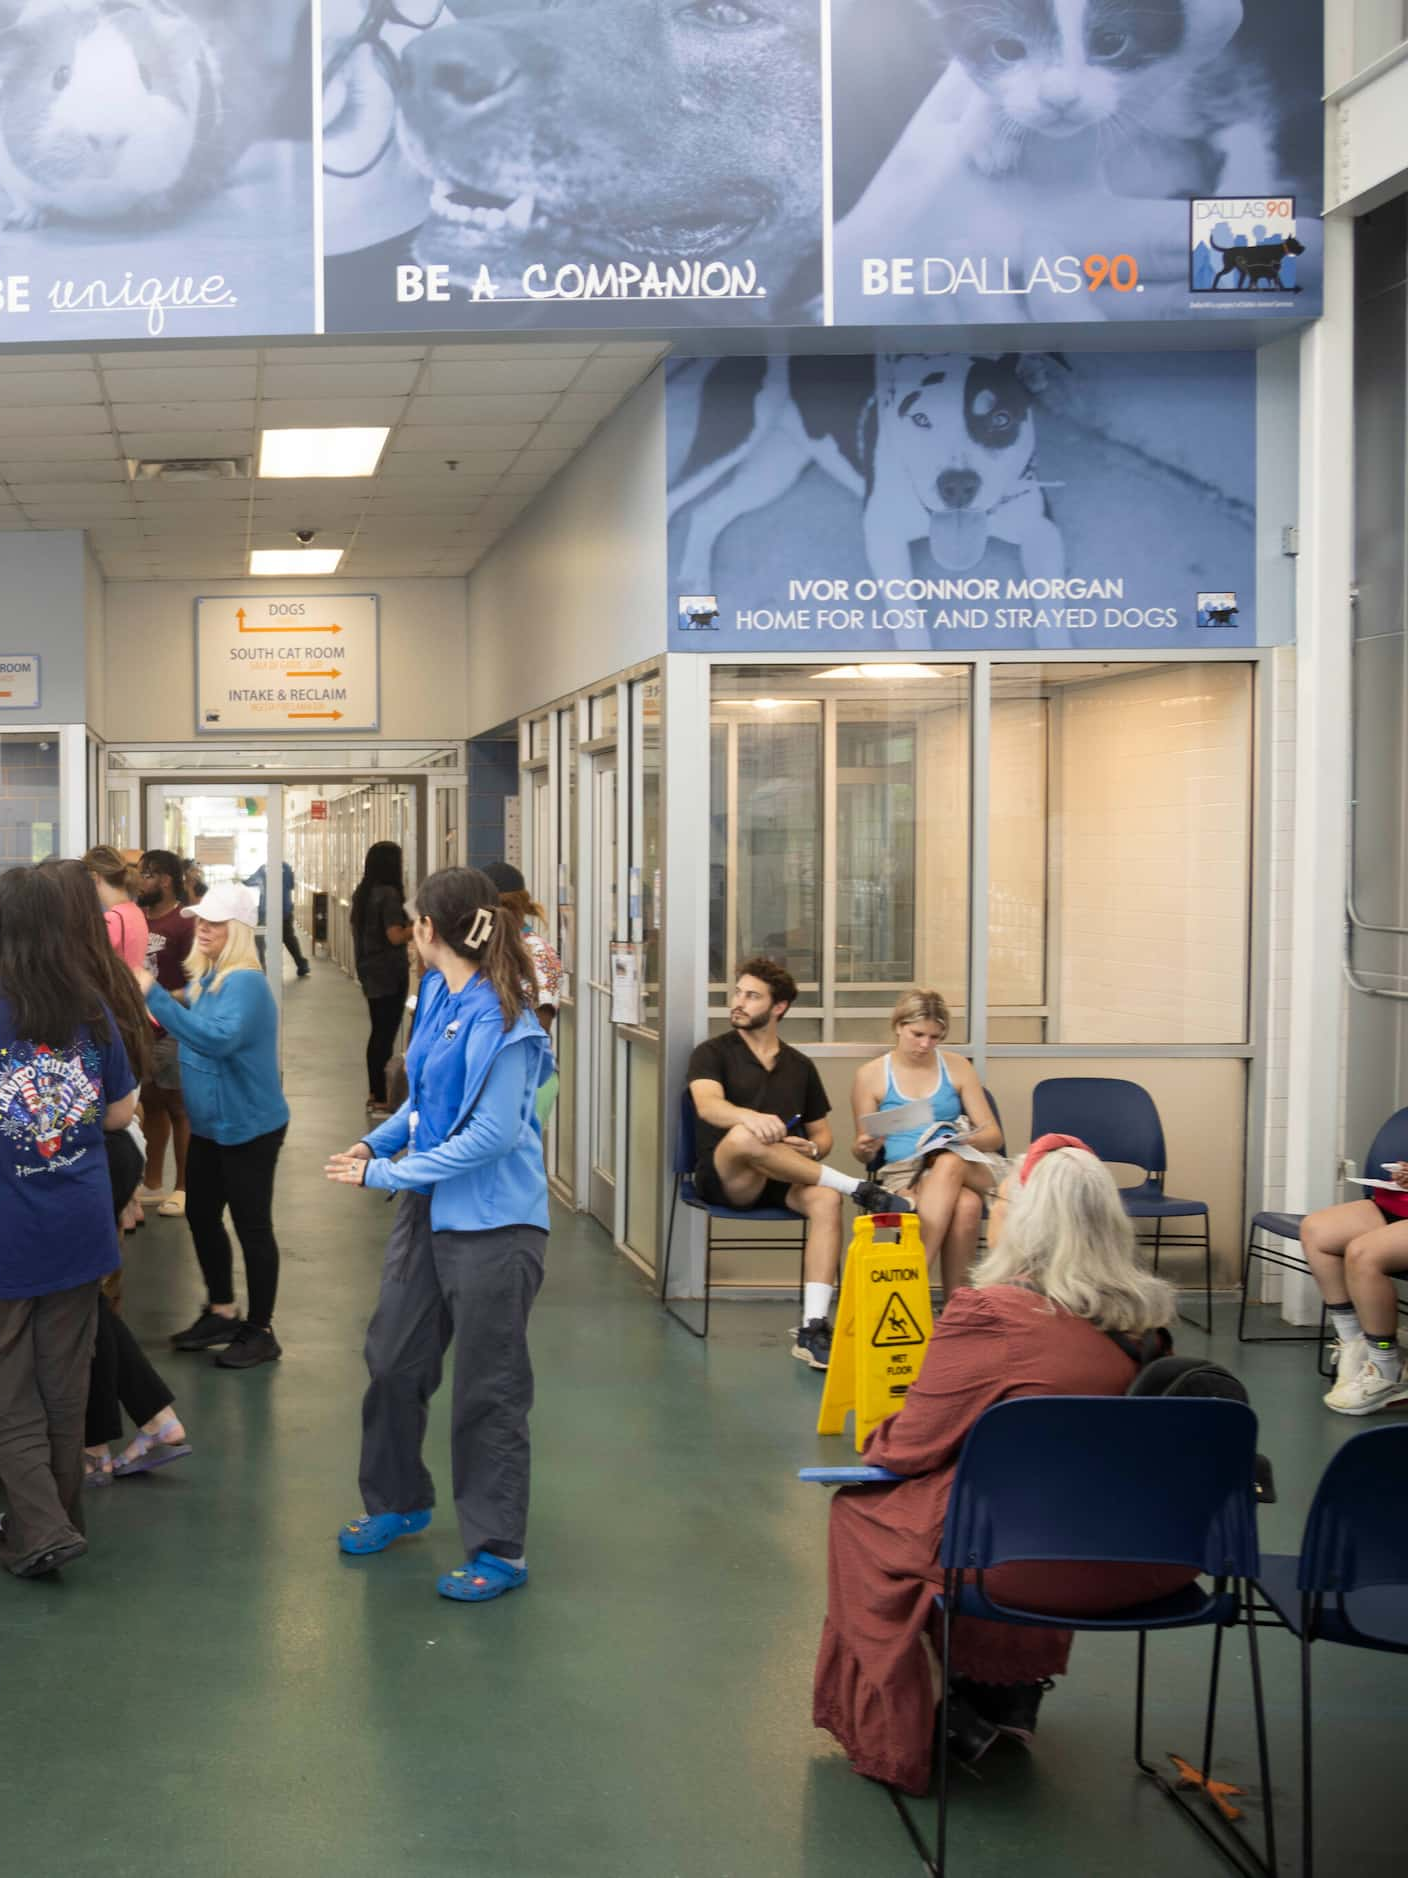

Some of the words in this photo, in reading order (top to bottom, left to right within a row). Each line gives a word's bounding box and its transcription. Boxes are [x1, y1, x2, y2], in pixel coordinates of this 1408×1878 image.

[1196, 201, 1289, 219] DALLAS90
[396, 264, 450, 301] BE
[471, 264, 499, 300] A
[522, 260, 766, 298] COMPANION.
[862, 258, 913, 296] BE
[923, 253, 1144, 295] DALLAS90.
[48, 272, 238, 335] unique.
[789, 580, 849, 600] IVOR
[855, 579, 999, 600] O'CONNOR
[1006, 578, 1124, 599] MORGAN
[269, 604, 305, 616] DOGS
[736, 610, 810, 630] HOME
[817, 610, 864, 630] FOR
[872, 609, 928, 629] LOST
[934, 608, 988, 629] AND
[995, 608, 1097, 628] STRAYED
[1104, 607, 1177, 628] DOGS
[230, 648, 274, 660] SOUTH
[278, 647, 303, 660] CAT
[305, 646, 345, 659] ROOM
[0, 663, 32, 673] ROOM
[228, 689, 273, 702] INTAKE
[278, 689, 287, 701] &
[290, 688, 347, 701] RECLAIM
[871, 1268, 919, 1282] CAUTION
[891, 1354, 908, 1363] WET
[887, 1366, 912, 1375] FLOOR
